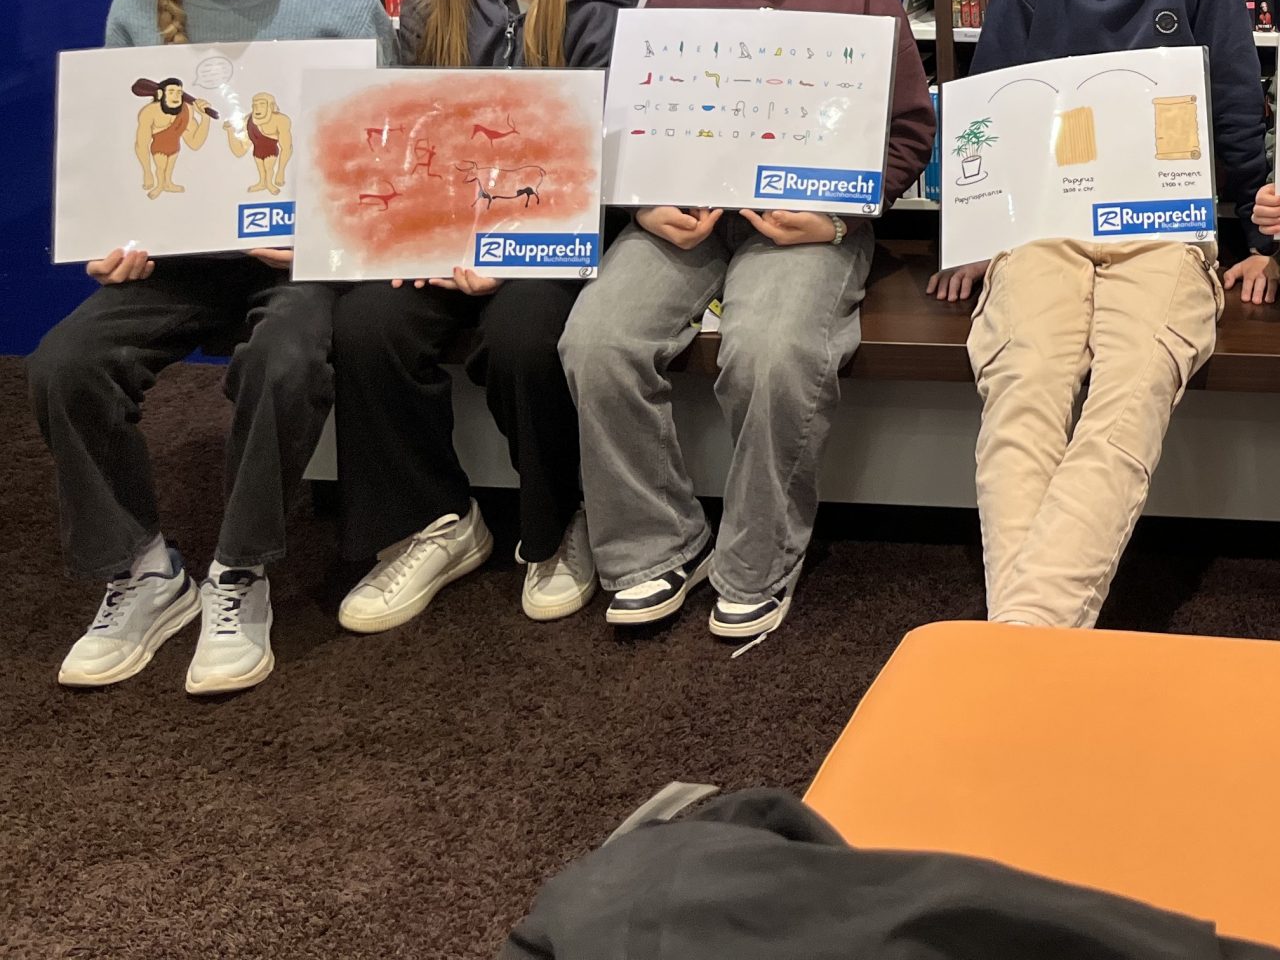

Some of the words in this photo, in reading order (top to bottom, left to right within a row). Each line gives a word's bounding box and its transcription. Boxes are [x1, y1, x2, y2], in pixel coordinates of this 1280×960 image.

[1158, 170, 1201, 179] Pergament
[786, 172, 874, 196] Rupprecht
[1063, 176, 1094, 185] Papyrus
[824, 192, 872, 200] Buchhandlung
[1123, 205, 1206, 228] Rupprecht
[505, 238, 592, 261] Rupprecht
[543, 255, 591, 264] Buchhandlung
